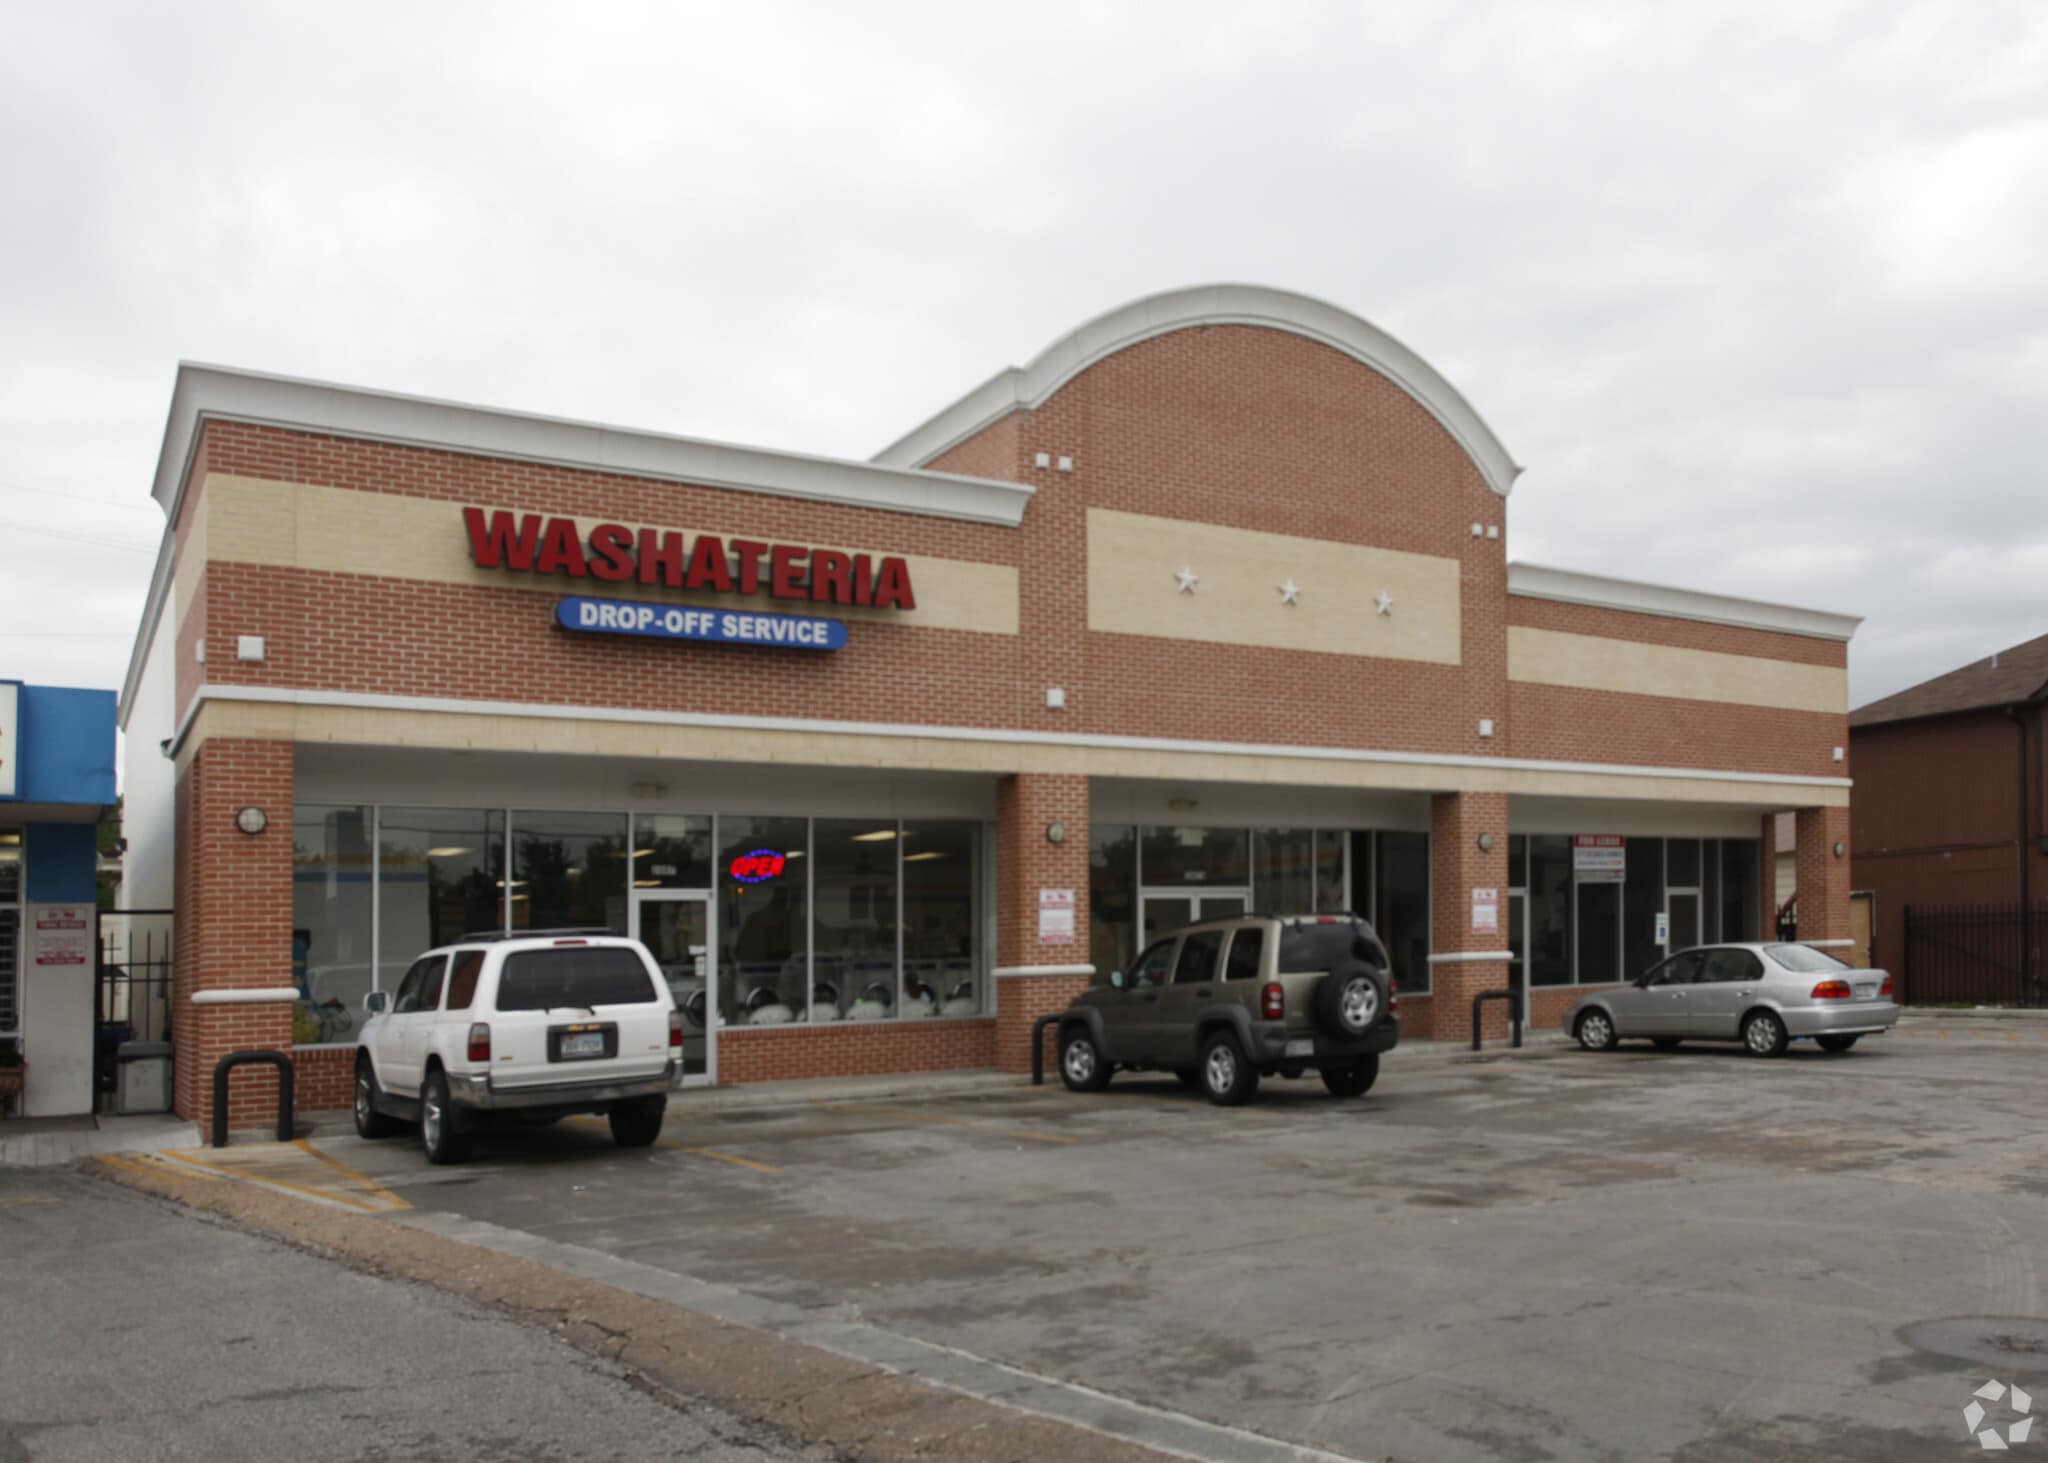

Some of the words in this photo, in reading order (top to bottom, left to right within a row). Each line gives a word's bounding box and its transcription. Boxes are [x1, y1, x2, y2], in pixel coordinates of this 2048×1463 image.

[463, 506, 916, 609] WASHATERIA
[579, 602, 714, 635] DROP-OFF
[722, 616, 829, 644] SERVICE
[730, 856, 785, 876] OPEN
